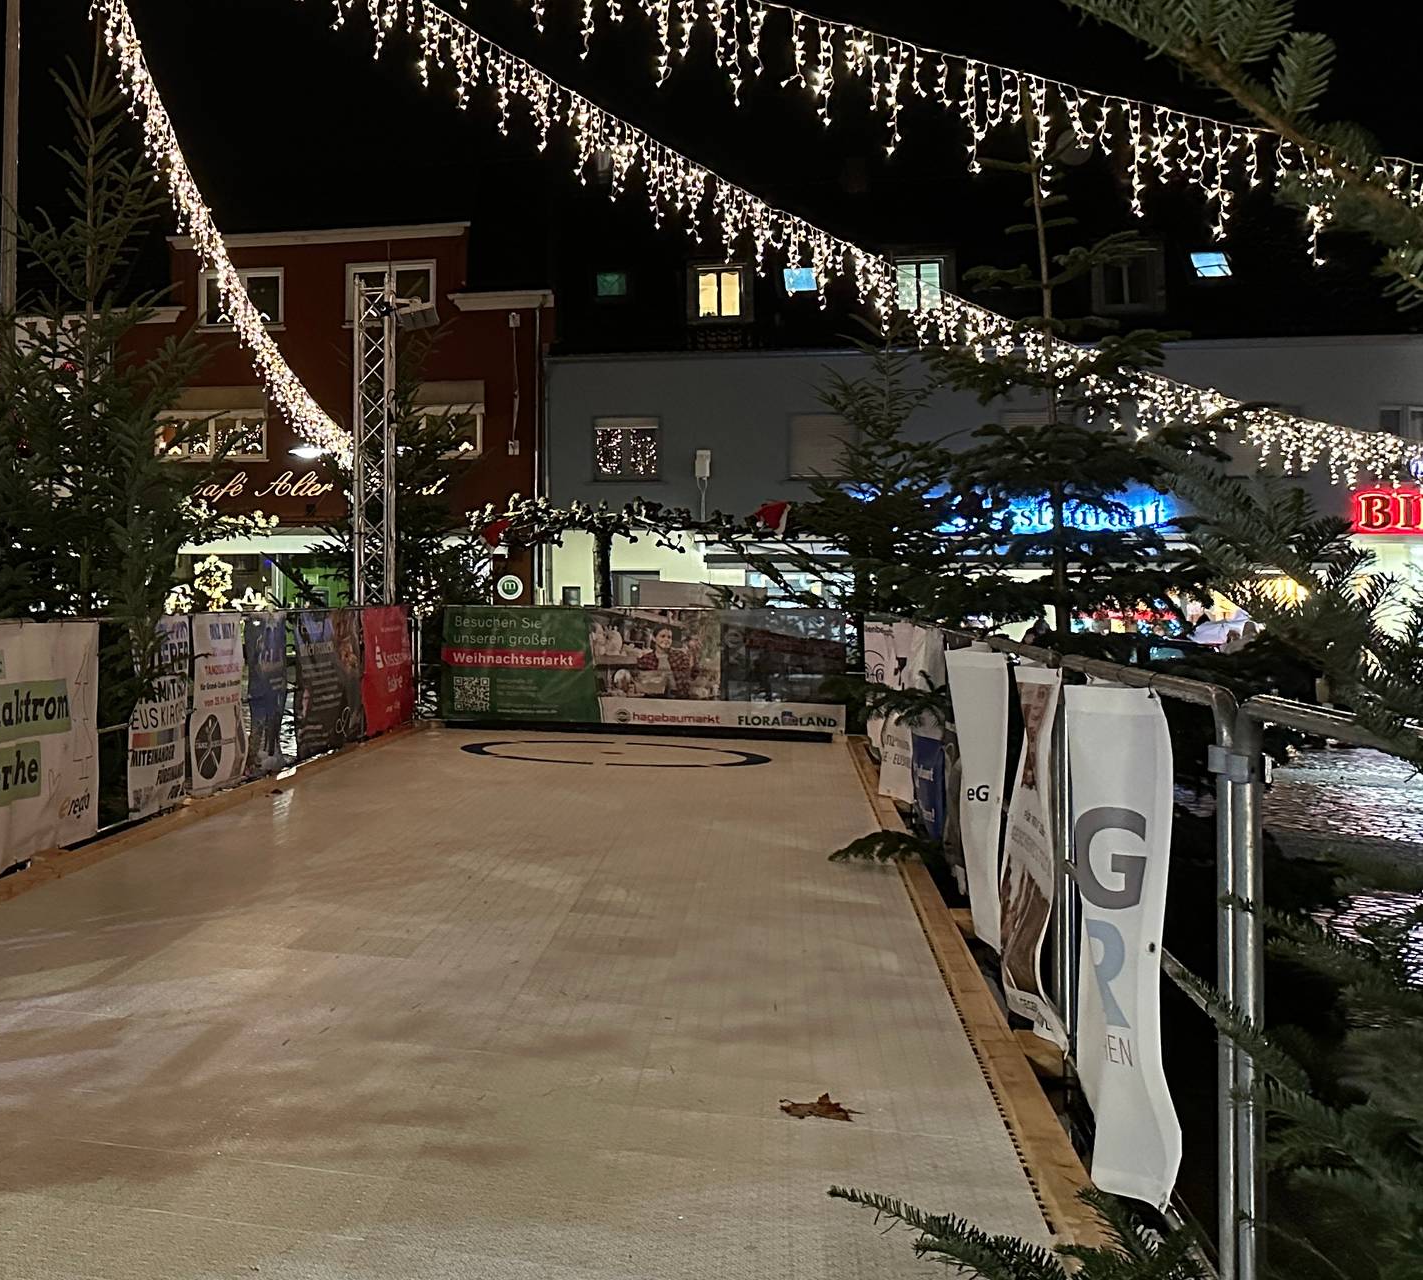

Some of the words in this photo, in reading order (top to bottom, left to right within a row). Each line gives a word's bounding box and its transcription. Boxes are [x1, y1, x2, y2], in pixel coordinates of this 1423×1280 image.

[254, 470, 333, 497] Alter
[1357, 491, 1423, 531] BI
[454, 615, 517, 629] Besuchen
[521, 617, 542, 629] Sie
[453, 634, 505, 645] unseren
[508, 633, 556, 647] großen
[452, 651, 574, 667] Weihnachtsmarkt
[632, 712, 721, 725] hagebaumarkt
[737, 715, 781, 728] FLORA
[799, 716, 837, 728] LAND
[967, 784, 989, 802] eG
[1073, 805, 1147, 911] G
